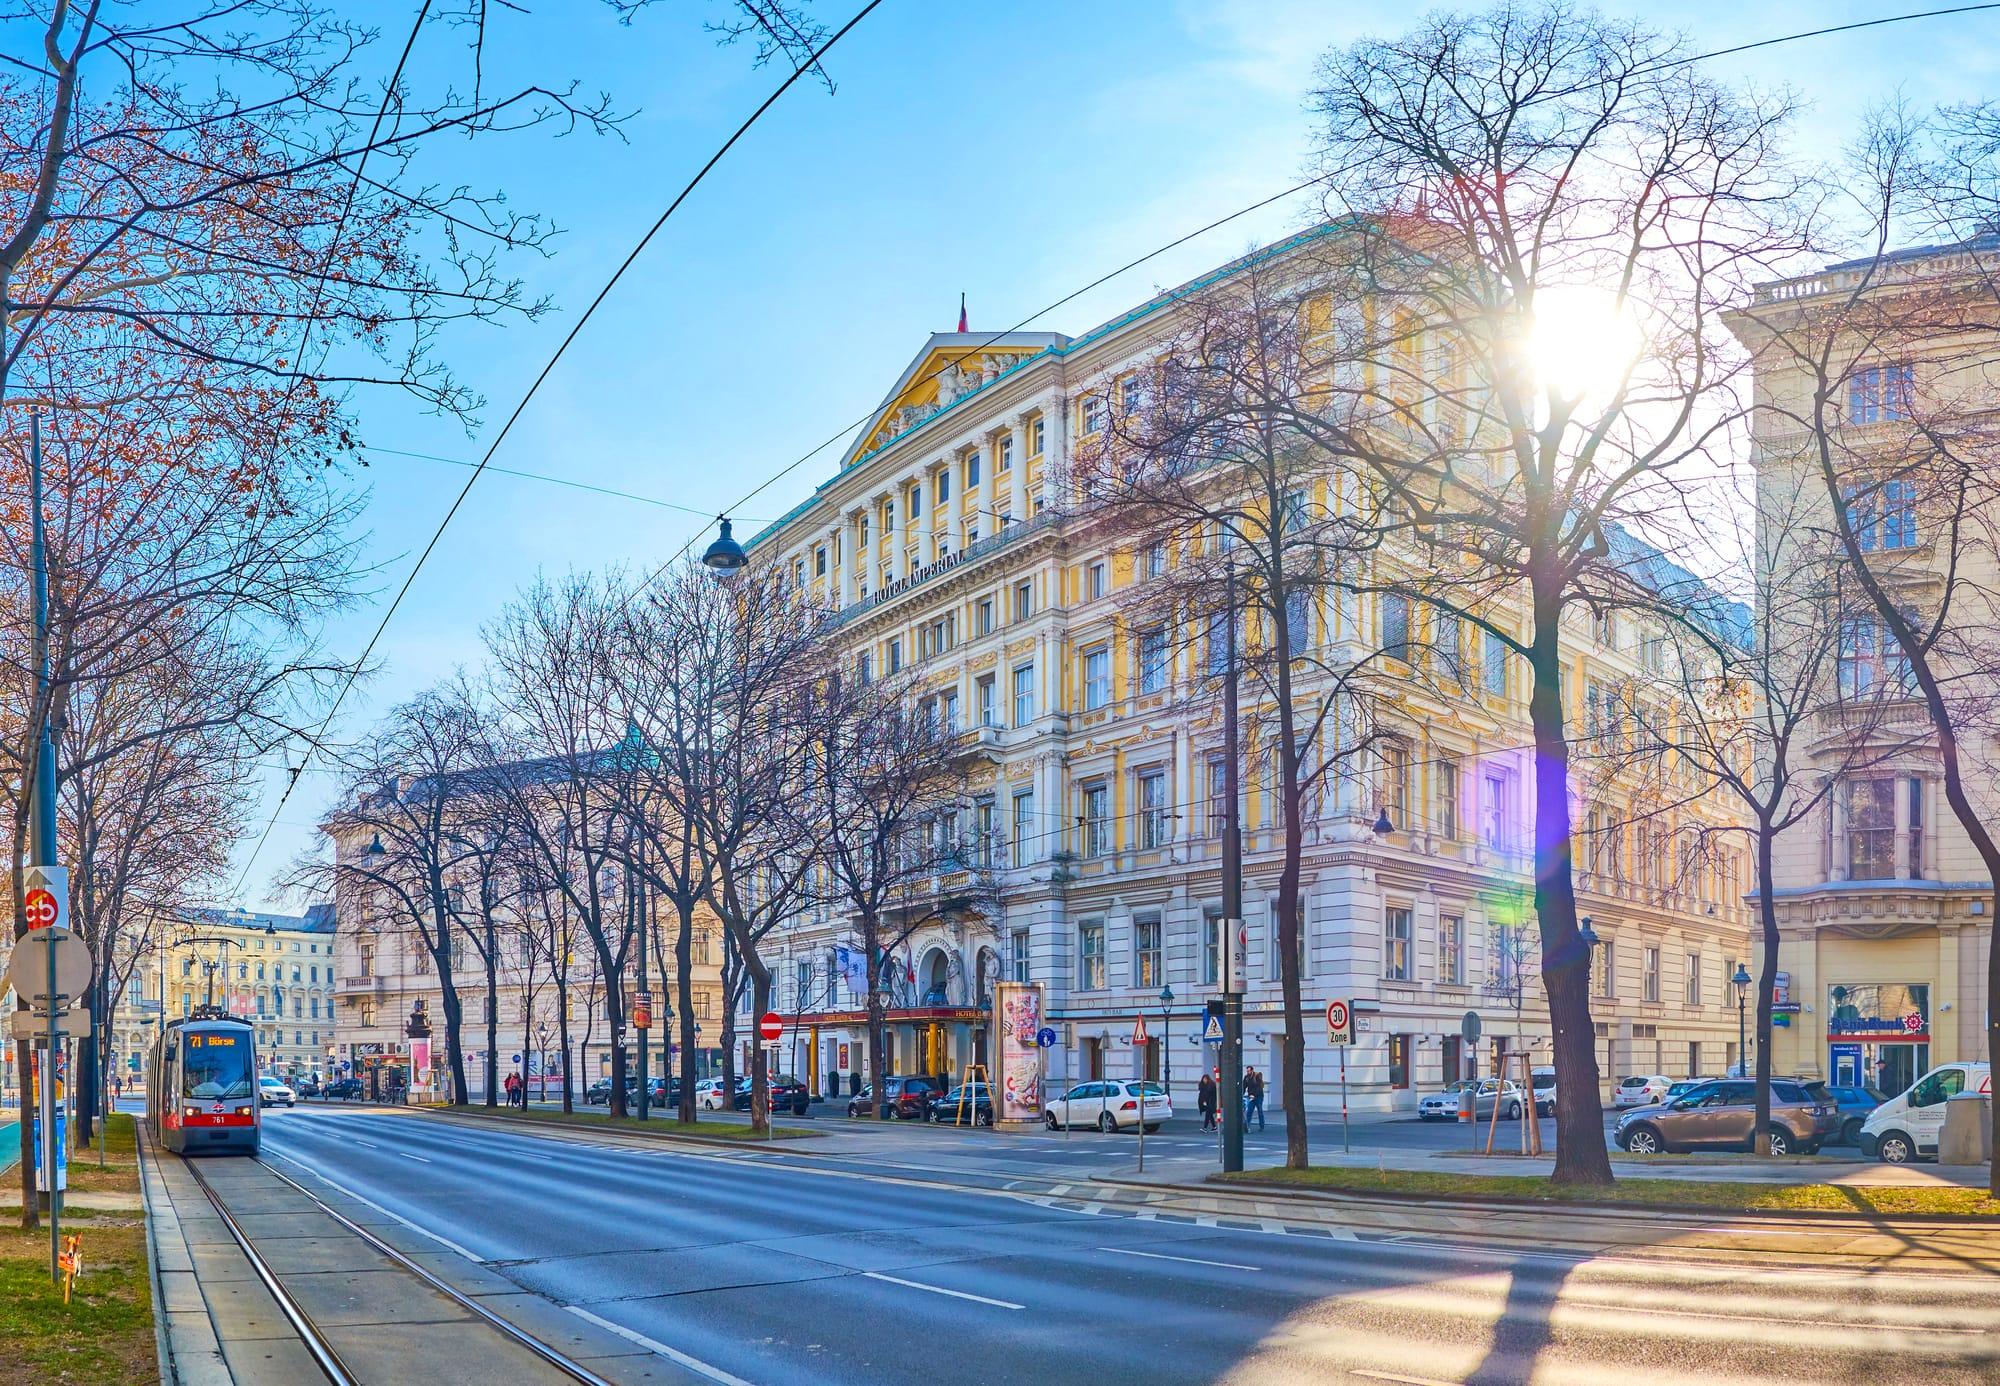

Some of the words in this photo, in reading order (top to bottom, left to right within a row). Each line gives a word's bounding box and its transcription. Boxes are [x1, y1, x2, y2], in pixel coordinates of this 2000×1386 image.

[873, 577, 908, 605] HOTEL
[910, 550, 965, 587] IMPERIAL
[1333, 1009, 1343, 1022] 30
[191, 1036, 201, 1047] 71
[208, 1036, 235, 1046] Börse
[1331, 1032, 1348, 1043] Zone
[213, 1116, 225, 1124] 761
